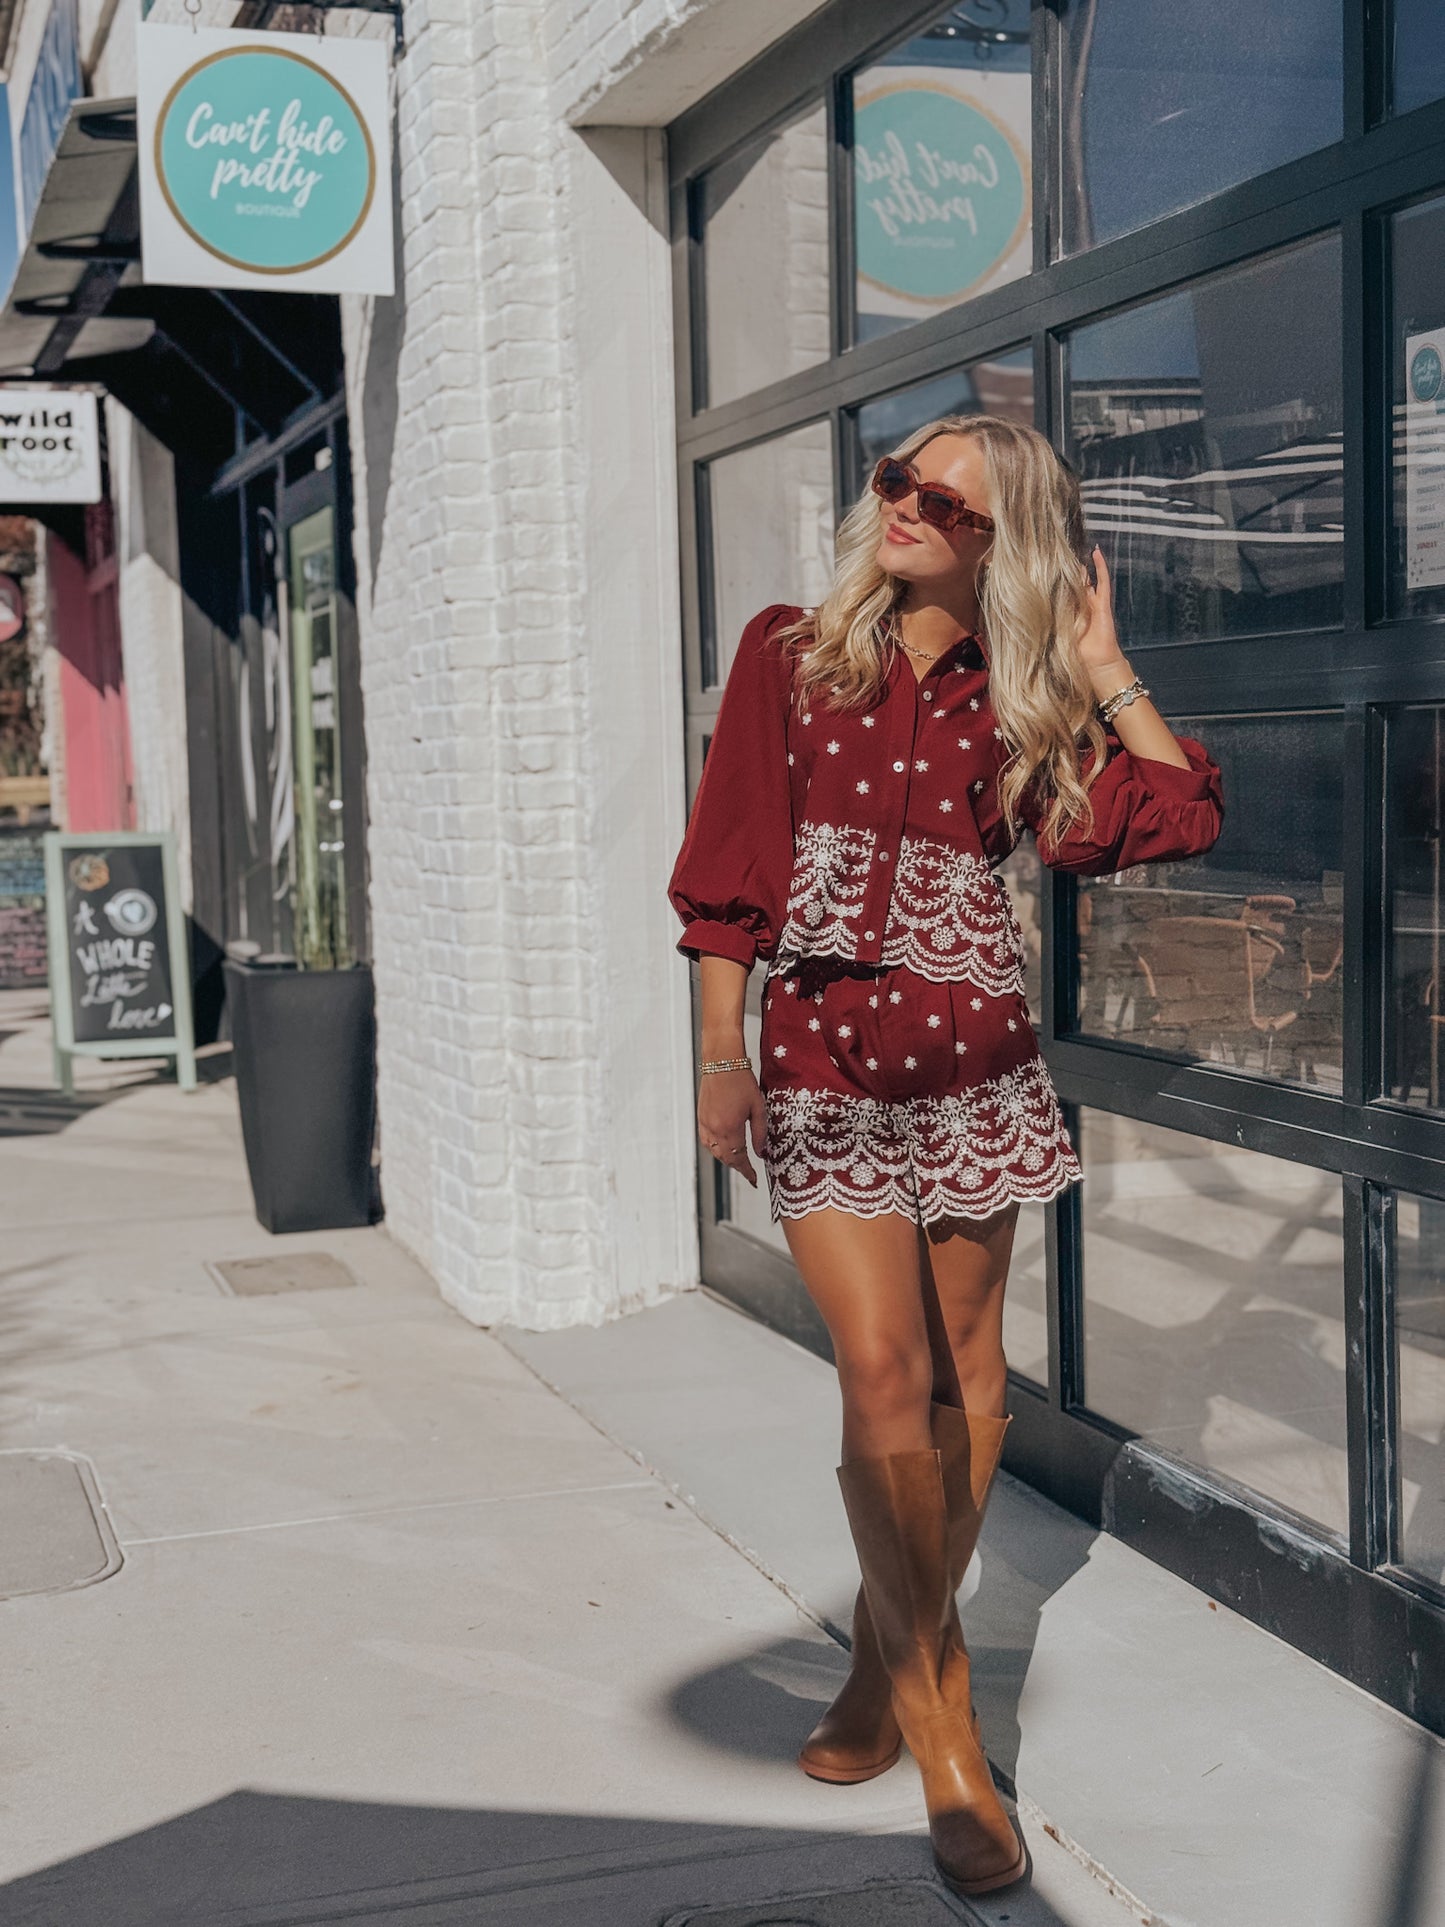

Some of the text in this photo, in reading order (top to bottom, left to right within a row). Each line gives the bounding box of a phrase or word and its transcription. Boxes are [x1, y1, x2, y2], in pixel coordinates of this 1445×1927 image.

[185, 98, 348, 155] Can't hide
[209, 148, 323, 208] pretty
[0, 410, 72, 428] wild
[76, 938, 155, 975] WHOLE
